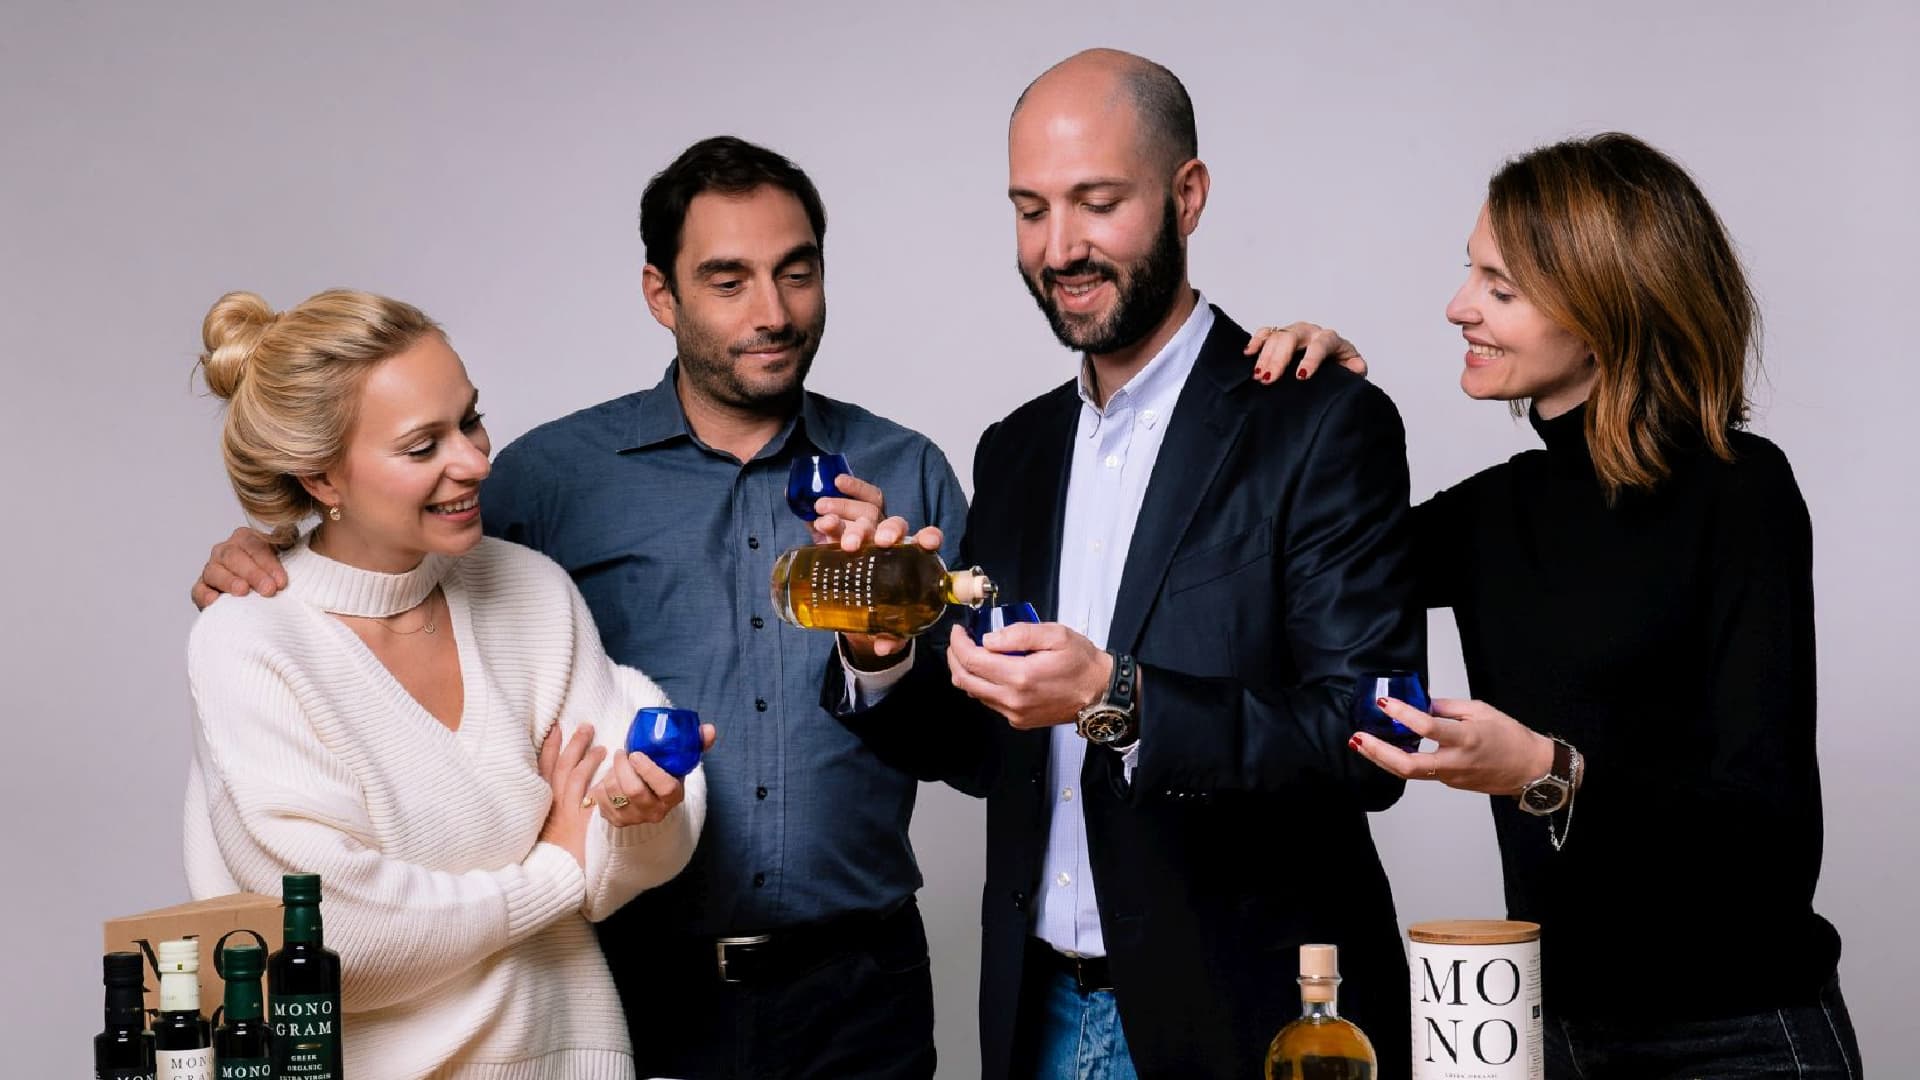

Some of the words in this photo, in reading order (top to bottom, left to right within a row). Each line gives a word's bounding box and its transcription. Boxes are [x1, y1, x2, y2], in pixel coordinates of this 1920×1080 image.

[1419, 957, 1520, 1006] MO
[274, 1000, 333, 1017] MONO
[276, 1020, 332, 1037] GRAM
[1424, 1016, 1518, 1066] NO
[290, 1054, 318, 1062] GREEK
[222, 1064, 271, 1078] MONO
[287, 1063, 323, 1071] ORGANIC
